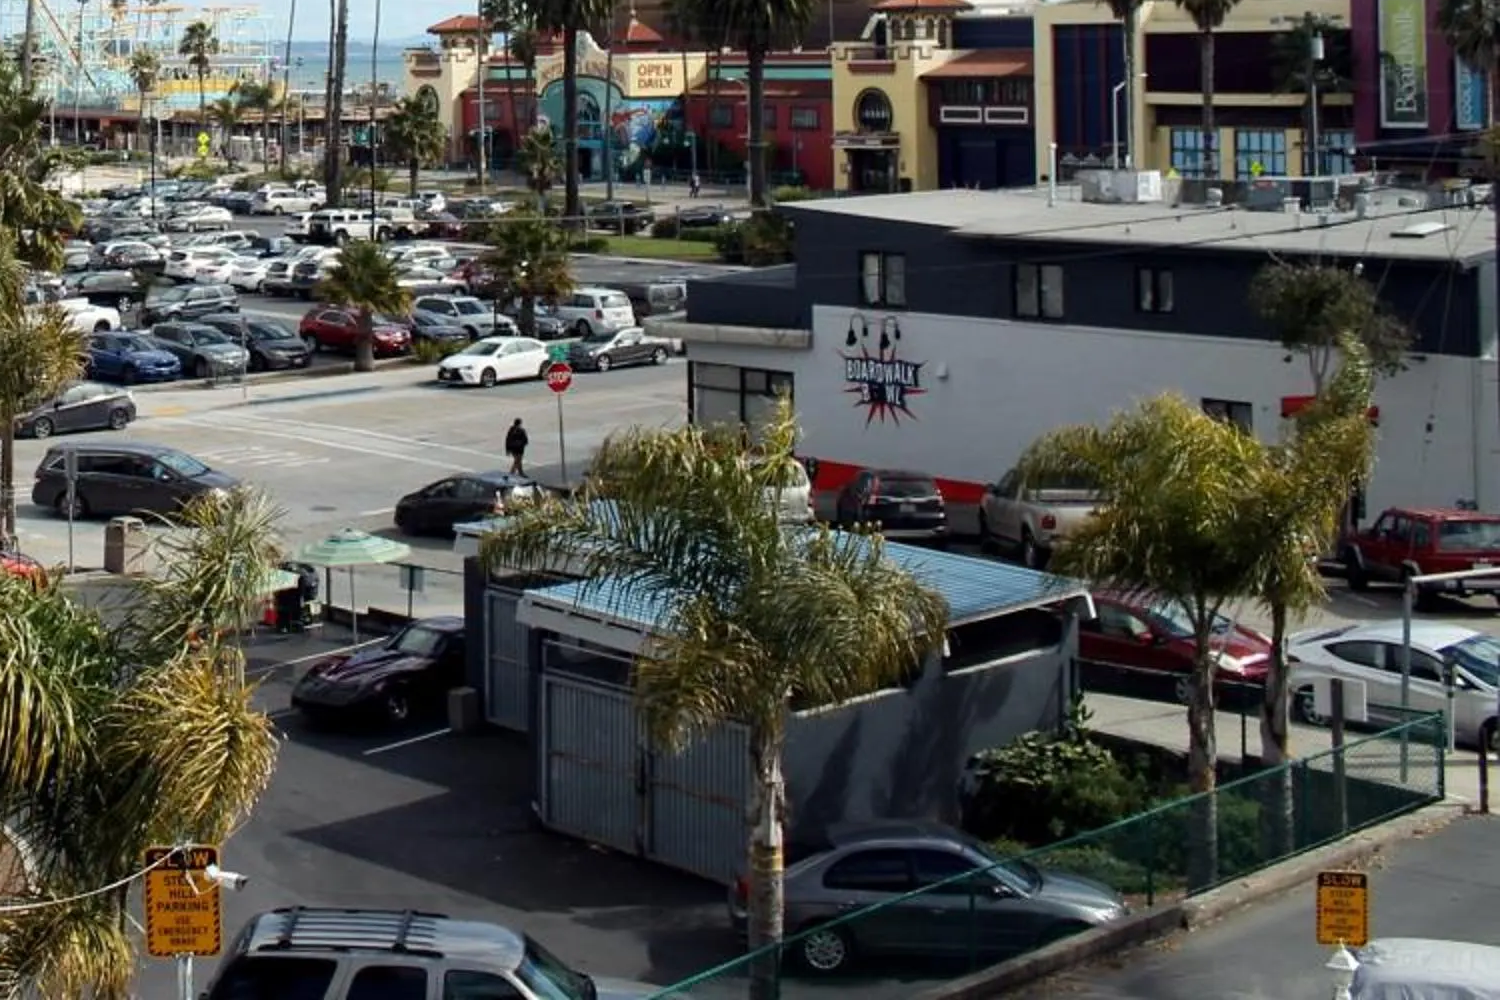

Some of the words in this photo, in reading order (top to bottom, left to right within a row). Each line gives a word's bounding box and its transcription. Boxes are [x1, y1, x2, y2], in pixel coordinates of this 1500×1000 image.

[637, 63, 673, 76] OPEN
[637, 78, 673, 89] DAILY
[548, 371, 571, 385] STOP
[846, 359, 915, 386] BOARDWALK
[1323, 873, 1361, 886] SLOW
[155, 901, 210, 912] PARKING
